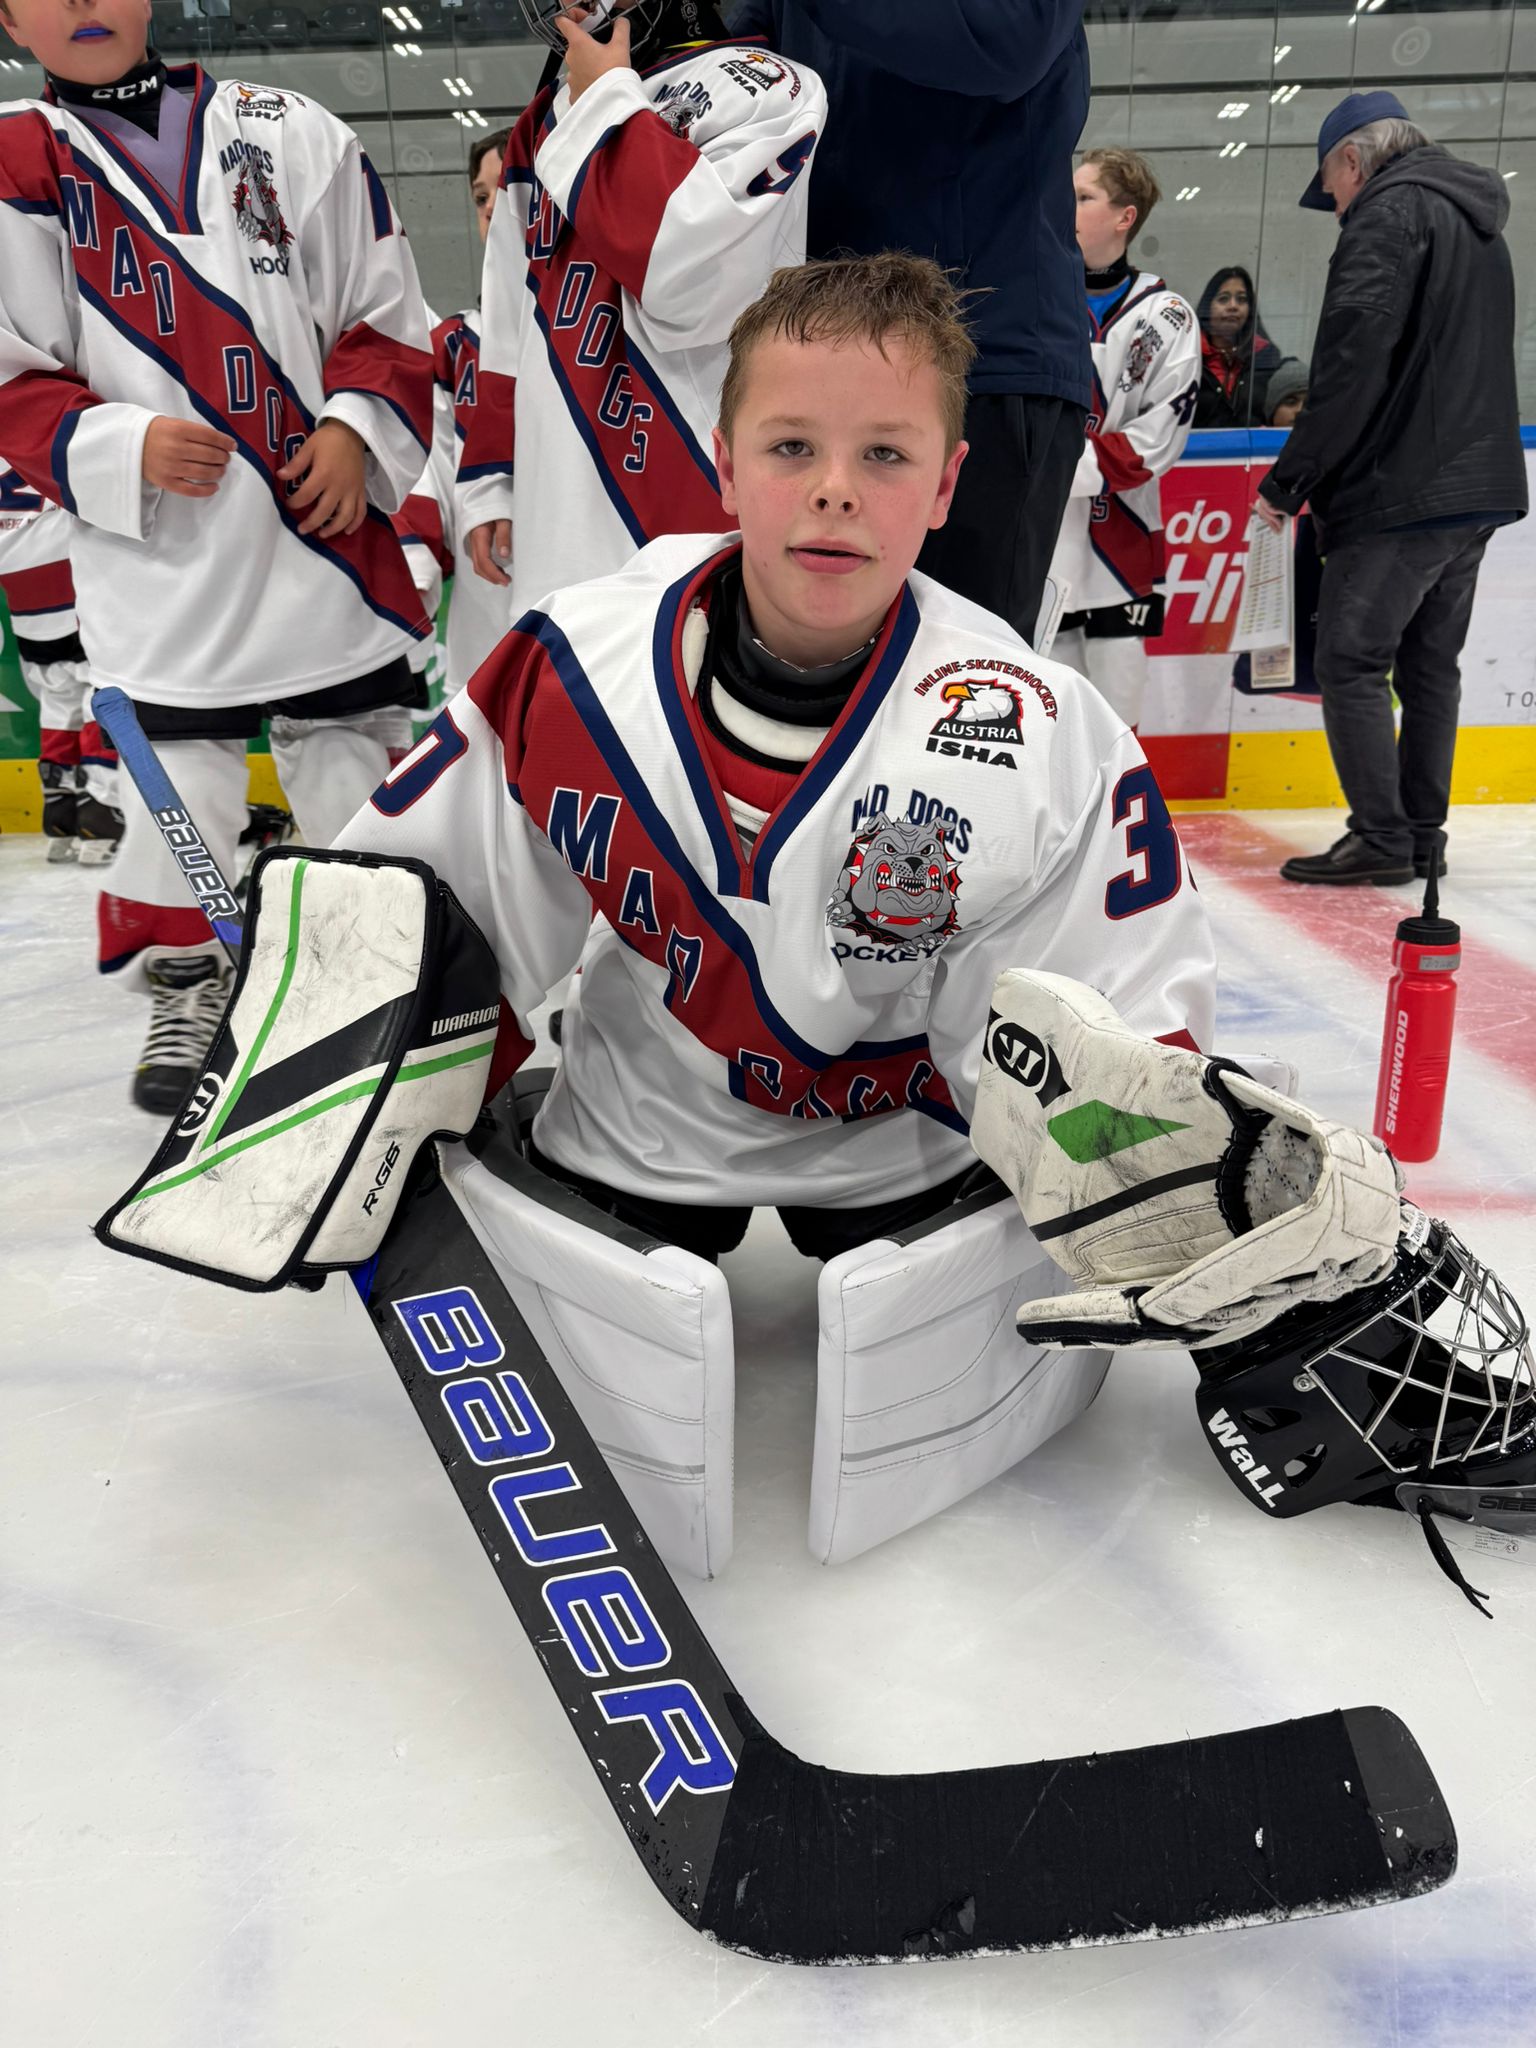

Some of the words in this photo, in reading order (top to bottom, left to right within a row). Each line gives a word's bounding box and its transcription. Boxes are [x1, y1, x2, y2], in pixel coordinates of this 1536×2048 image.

[91, 75, 158, 100] CCM
[718, 63, 757, 97] ISHA
[732, 61, 769, 88] AUSTRIA
[60, 174, 176, 336] MAD
[554, 261, 654, 473] DOGS
[1165, 500, 1232, 544] do
[913, 659, 1058, 722] INLINE-SKATERHOCKEY
[938, 722, 1019, 740] AUSTRIA
[925, 737, 1018, 770] ISHA
[908, 789, 973, 854] DOGS
[547, 786, 704, 1004] MAD
[831, 942, 942, 968] OCKEY
[431, 1004, 500, 1037] WARRIOR
[1385, 1010, 1409, 1135] SHERWOOD
